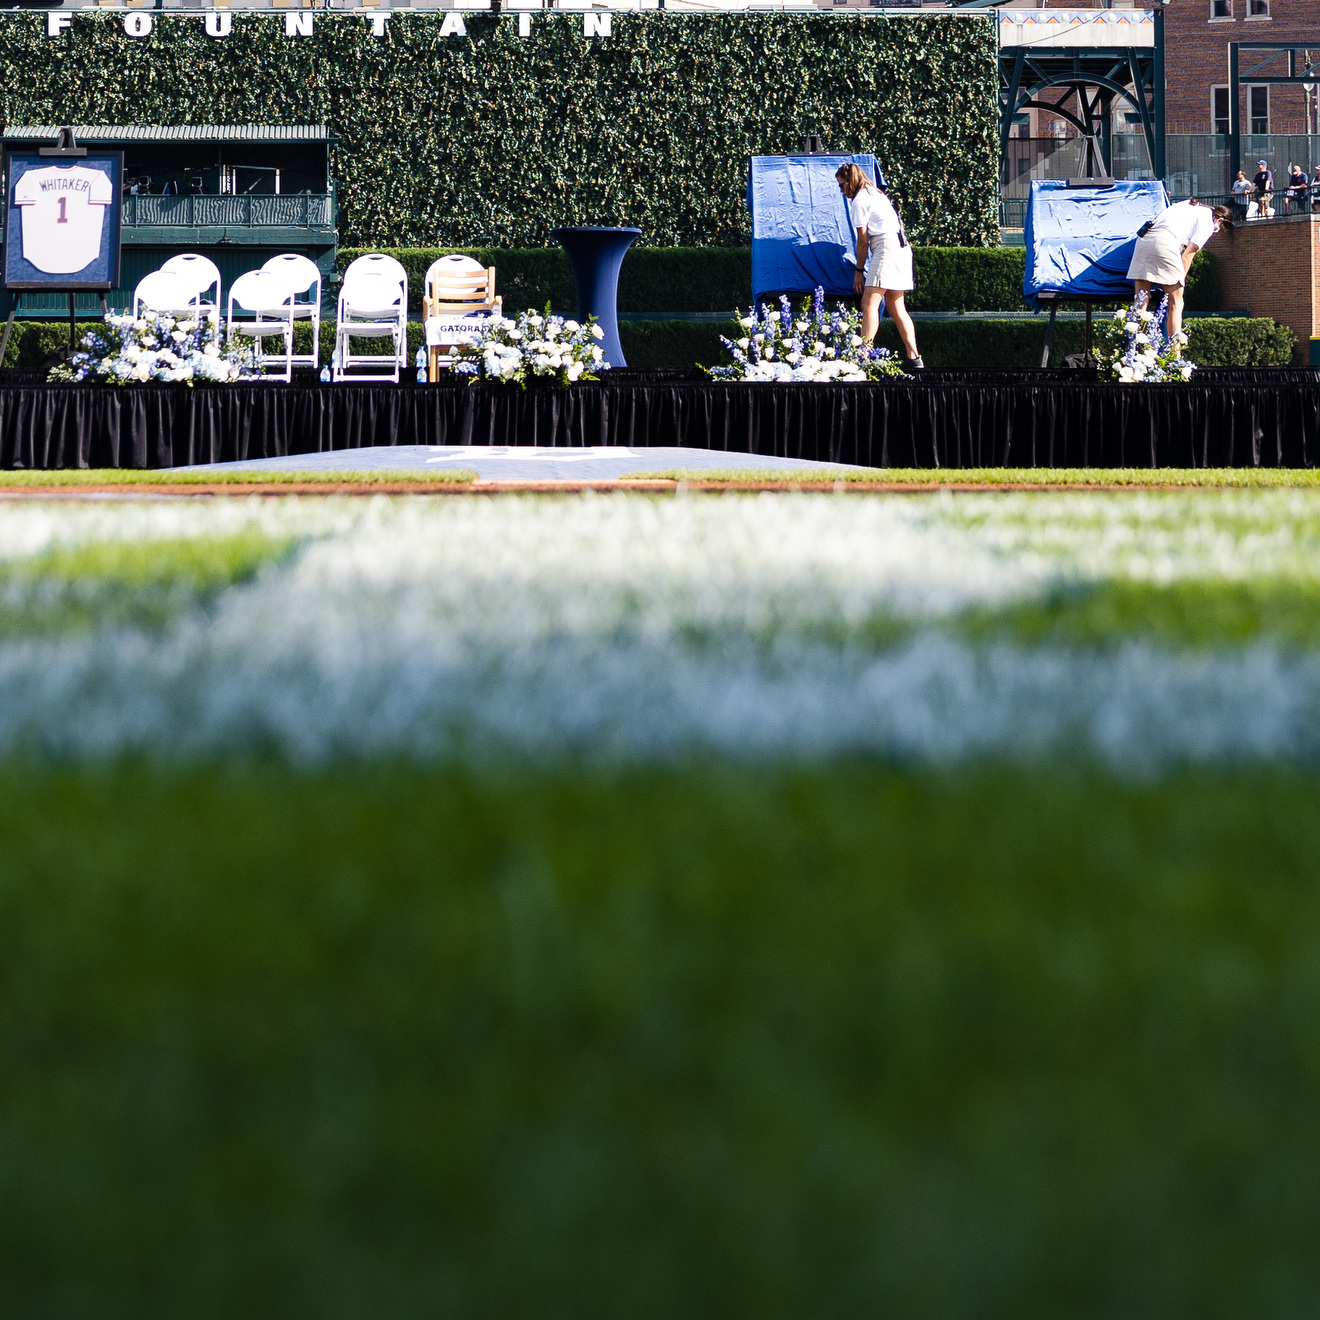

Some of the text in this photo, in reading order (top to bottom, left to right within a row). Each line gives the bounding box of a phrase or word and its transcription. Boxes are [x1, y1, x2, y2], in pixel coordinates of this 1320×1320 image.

[48, 12, 612, 37] FOUNTAIN
[39, 178, 90, 192] WHITAKER
[57, 196, 68, 224] 1
[440, 324, 489, 333] GATORAD
